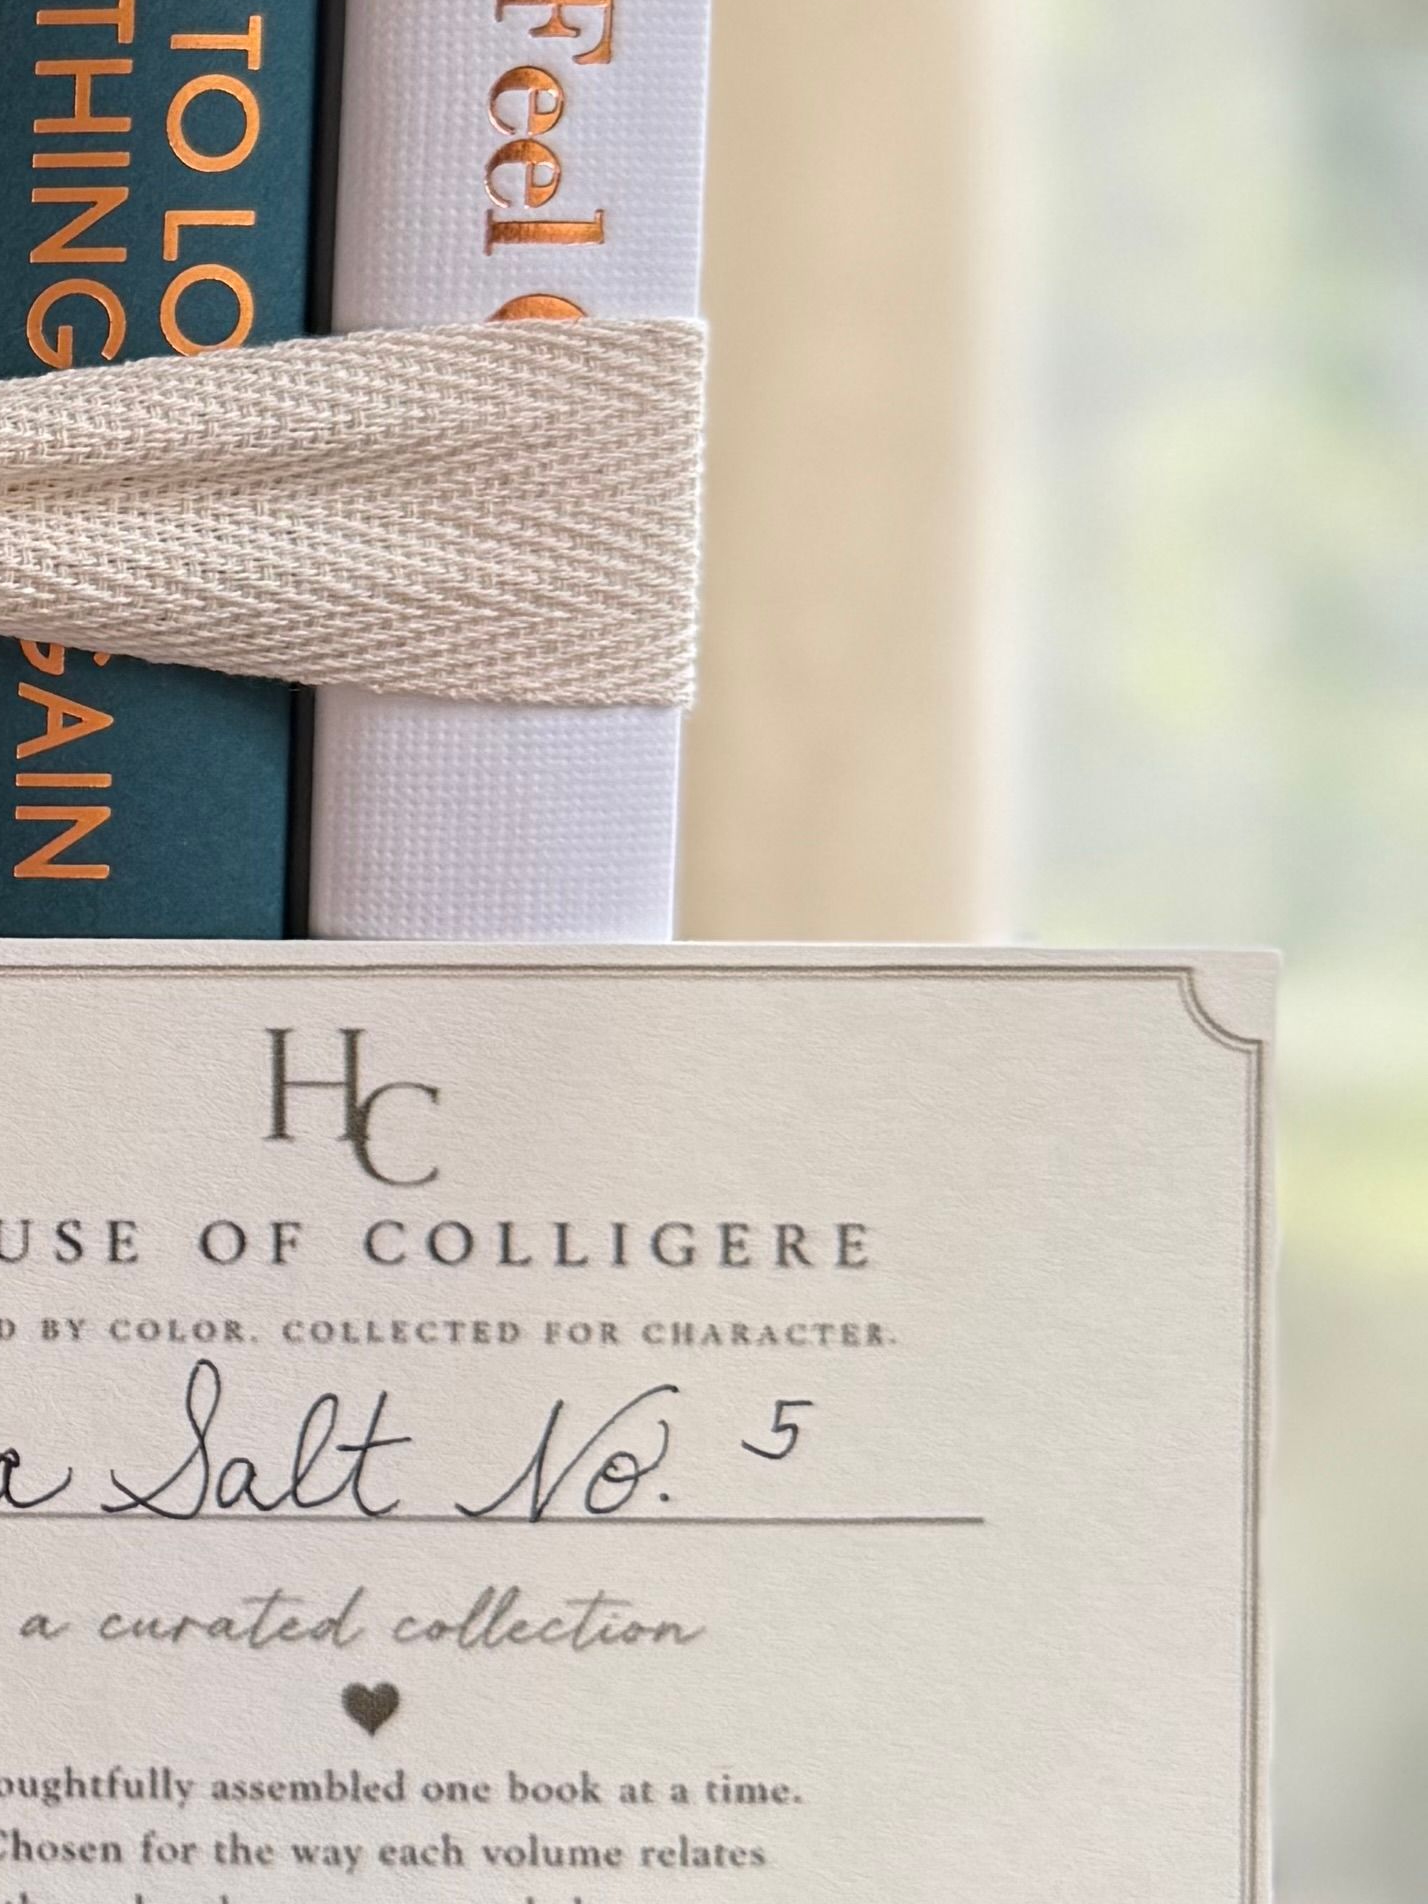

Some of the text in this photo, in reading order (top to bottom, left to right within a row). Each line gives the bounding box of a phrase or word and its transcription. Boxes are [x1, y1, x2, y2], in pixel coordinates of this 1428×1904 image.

[166, 15, 263, 173] TO
[197, 1219, 303, 1267] OF
[362, 1218, 869, 1270] COLLIGERE
[40, 1317, 87, 1342] BY
[280, 1319, 522, 1345] COLLECTED
[543, 1320, 621, 1346] FOR
[640, 1321, 897, 1348] CHARACTER.
[100, 1359, 412, 1520] Salt
[742, 1399, 814, 1458] 5
[18, 1584, 706, 1654] a curated collection
[210, 1767, 407, 1804] assembled
[420, 1781, 492, 1804] one
[507, 1769, 603, 1805] book
[618, 1780, 655, 1805] at
[669, 1783, 690, 1805] a
[705, 1773, 803, 1806] time.
[140, 1828, 198, 1866] for
[213, 1830, 275, 1867] the
[290, 1843, 364, 1876] way
[377, 1831, 466, 1868] each
[481, 1832, 624, 1869] volume
[640, 1833, 768, 1869] relates
